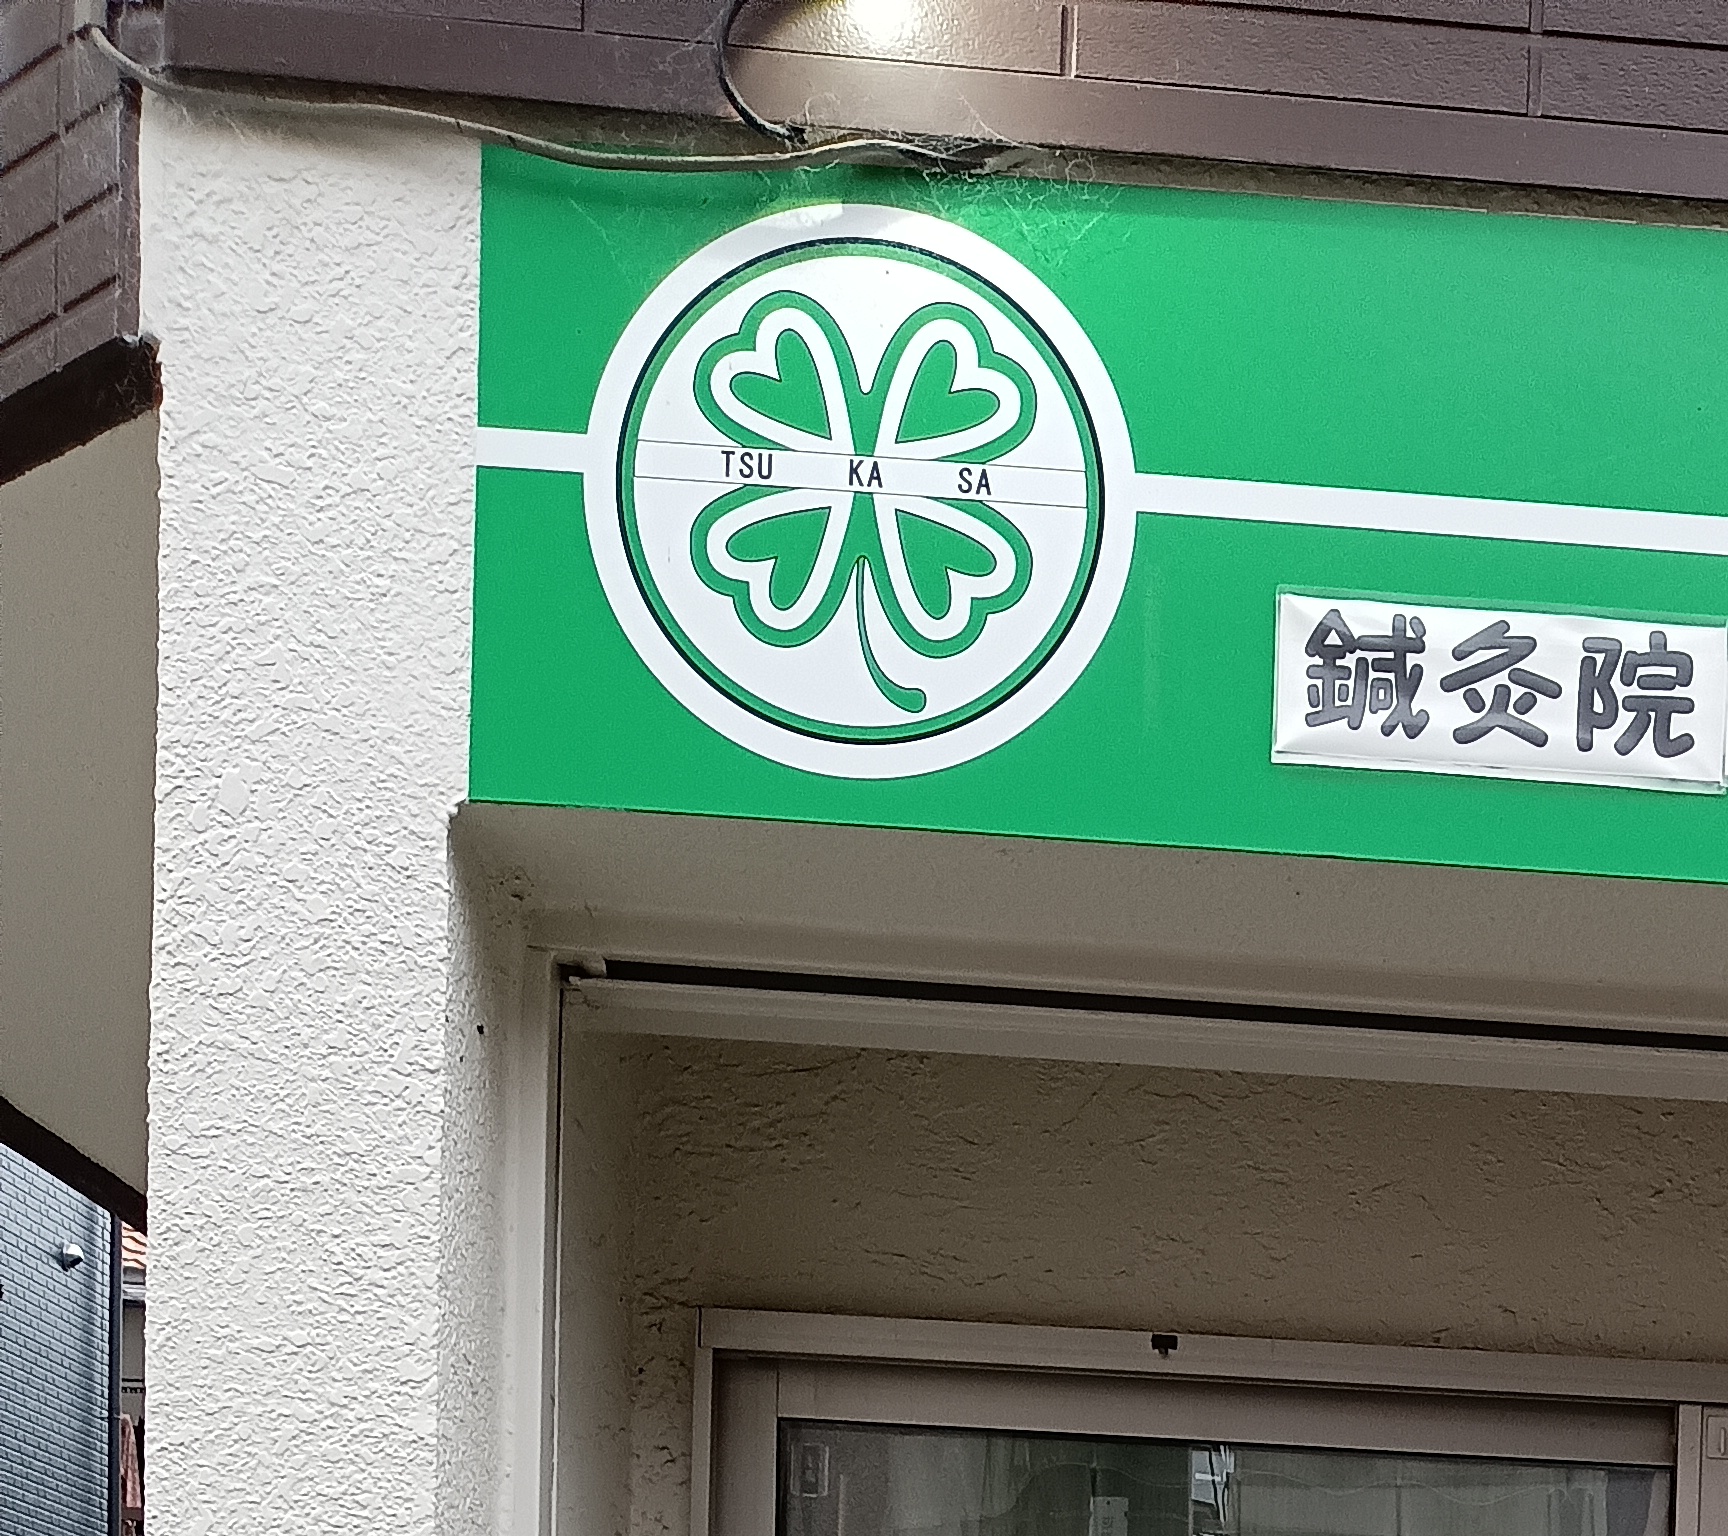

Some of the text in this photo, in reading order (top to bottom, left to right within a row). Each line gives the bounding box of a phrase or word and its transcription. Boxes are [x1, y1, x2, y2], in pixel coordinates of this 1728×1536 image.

[721, 450, 993, 498] TSU KA SA
[1303, 607, 1697, 758] 鍼灸院
